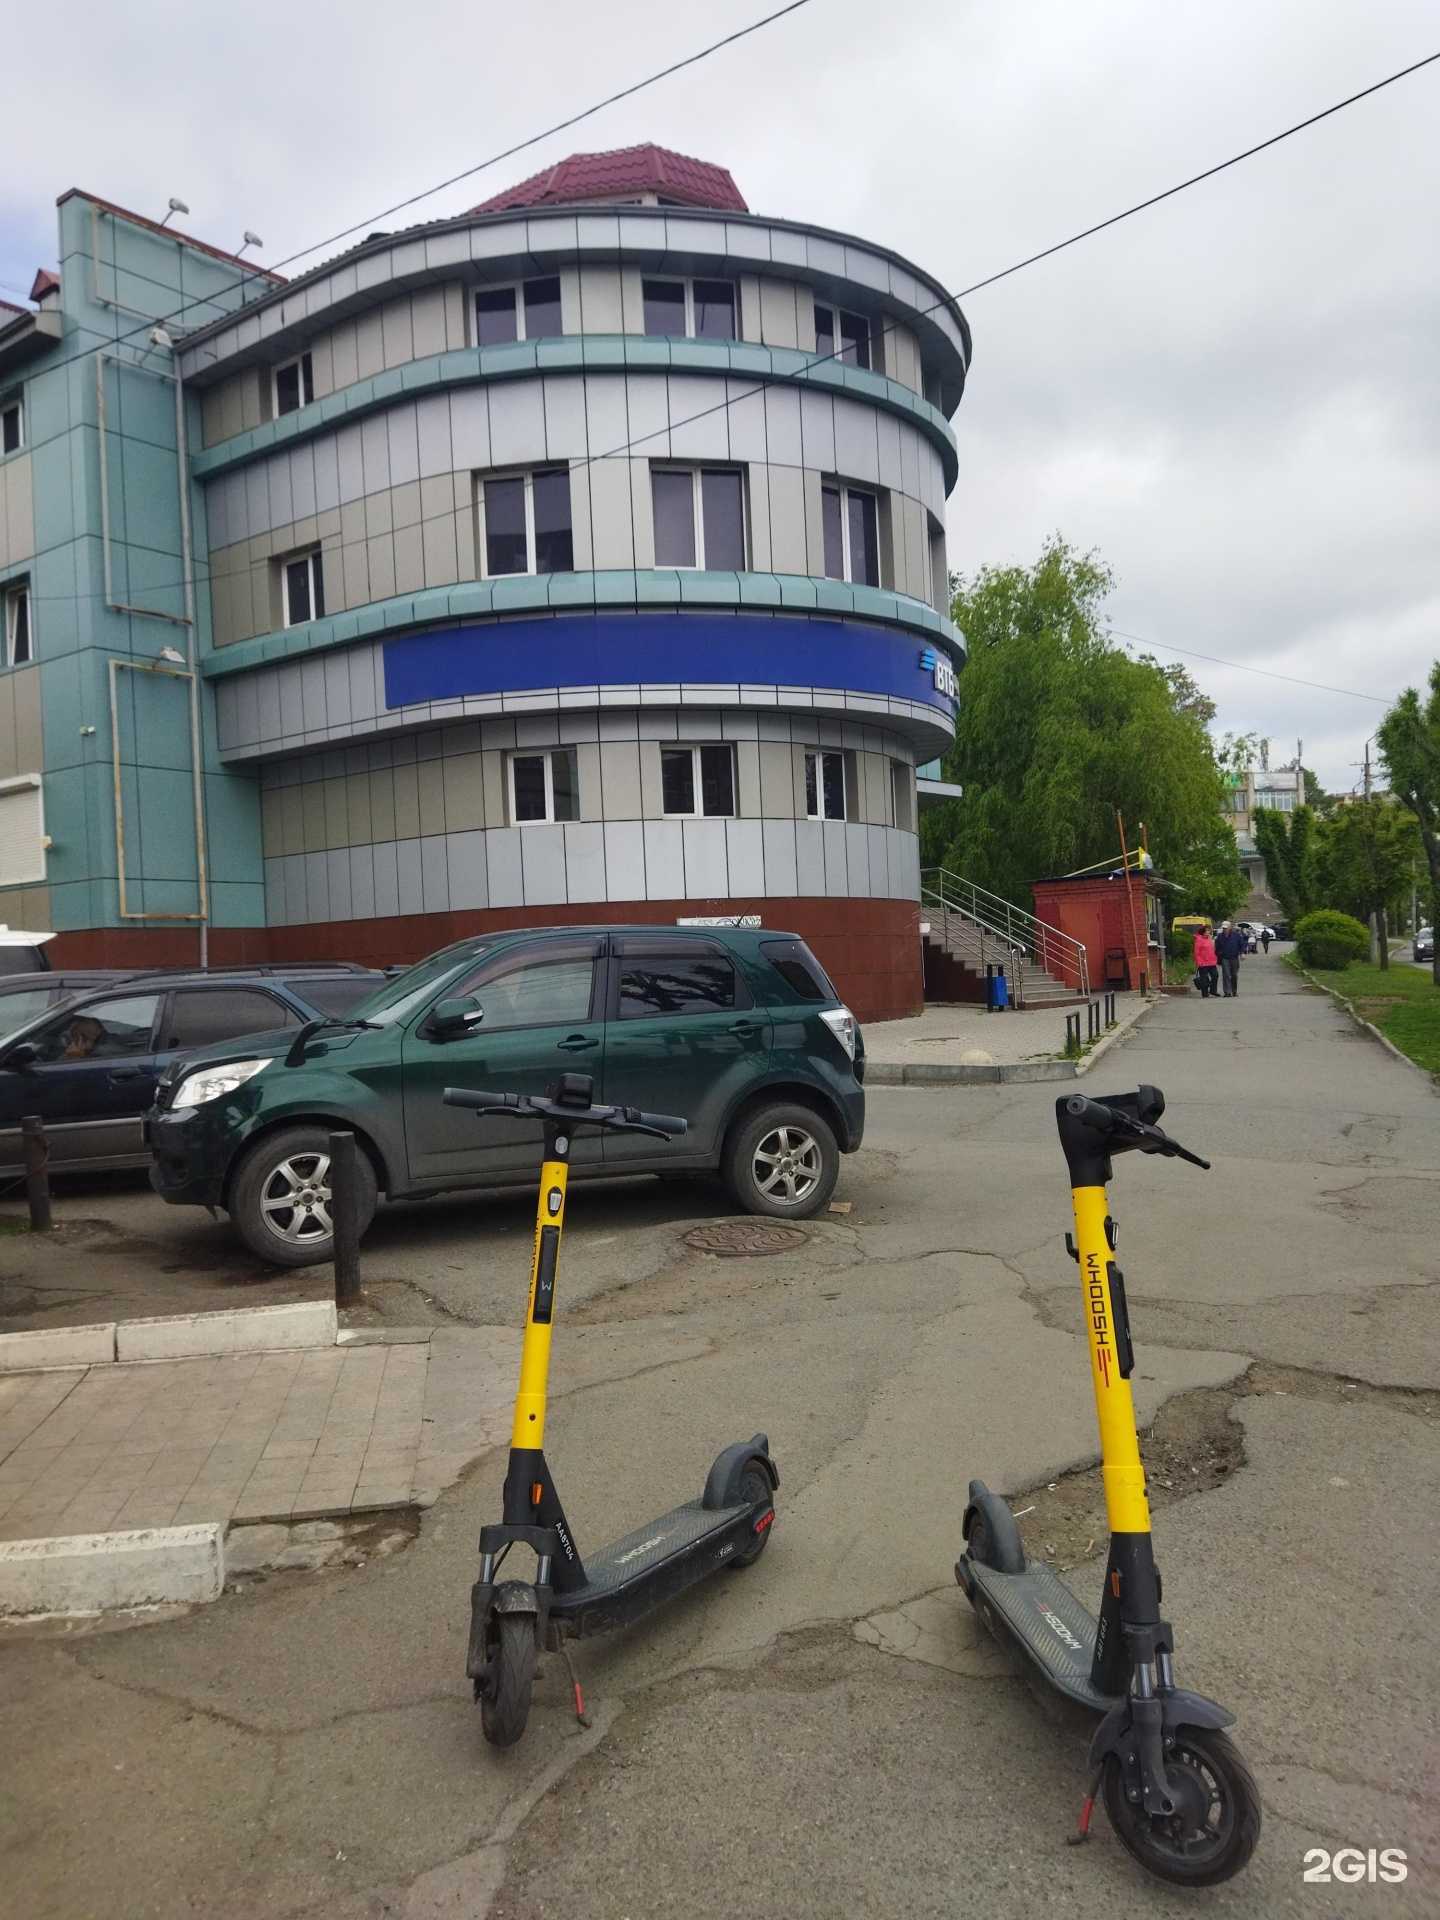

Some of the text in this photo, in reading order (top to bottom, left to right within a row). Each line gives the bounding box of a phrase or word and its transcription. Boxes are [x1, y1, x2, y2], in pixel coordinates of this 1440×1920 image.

[1085, 1252, 1110, 1345] WHOOSH
[555, 1522, 574, 1560] AA8704
[614, 1535, 667, 1566] WHOOSH
[1040, 1611, 1083, 1649] WHOOSH
